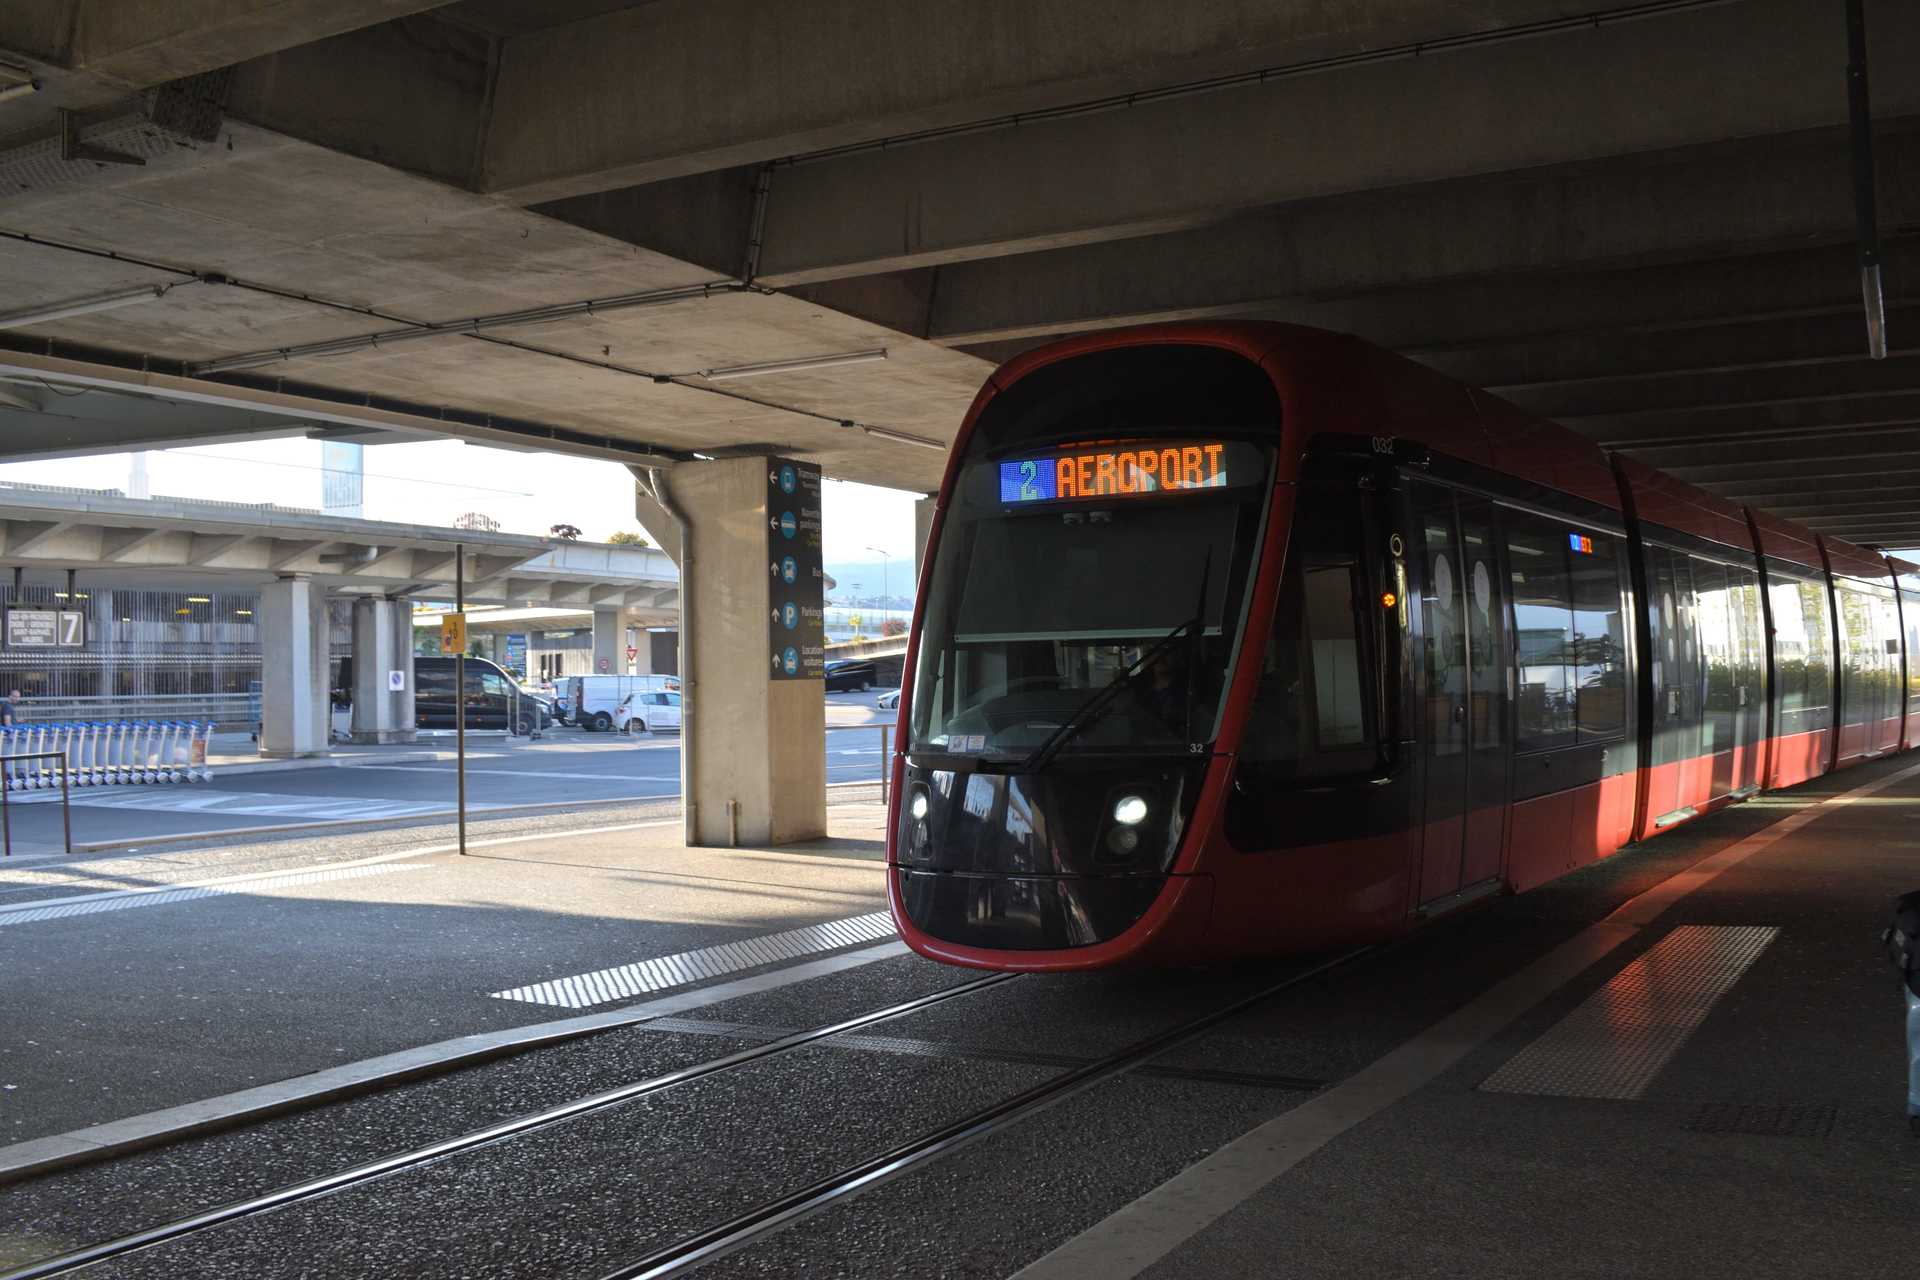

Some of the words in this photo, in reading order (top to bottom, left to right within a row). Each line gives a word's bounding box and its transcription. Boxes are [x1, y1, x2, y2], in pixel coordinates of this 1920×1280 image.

[1372, 436, 1394, 455] 032
[1020, 461, 1037, 500] 2
[1057, 445, 1222, 498] AEROPORT
[787, 606, 794, 624] P
[64, 615, 78, 643] 7
[1190, 743, 1204, 753] 32
